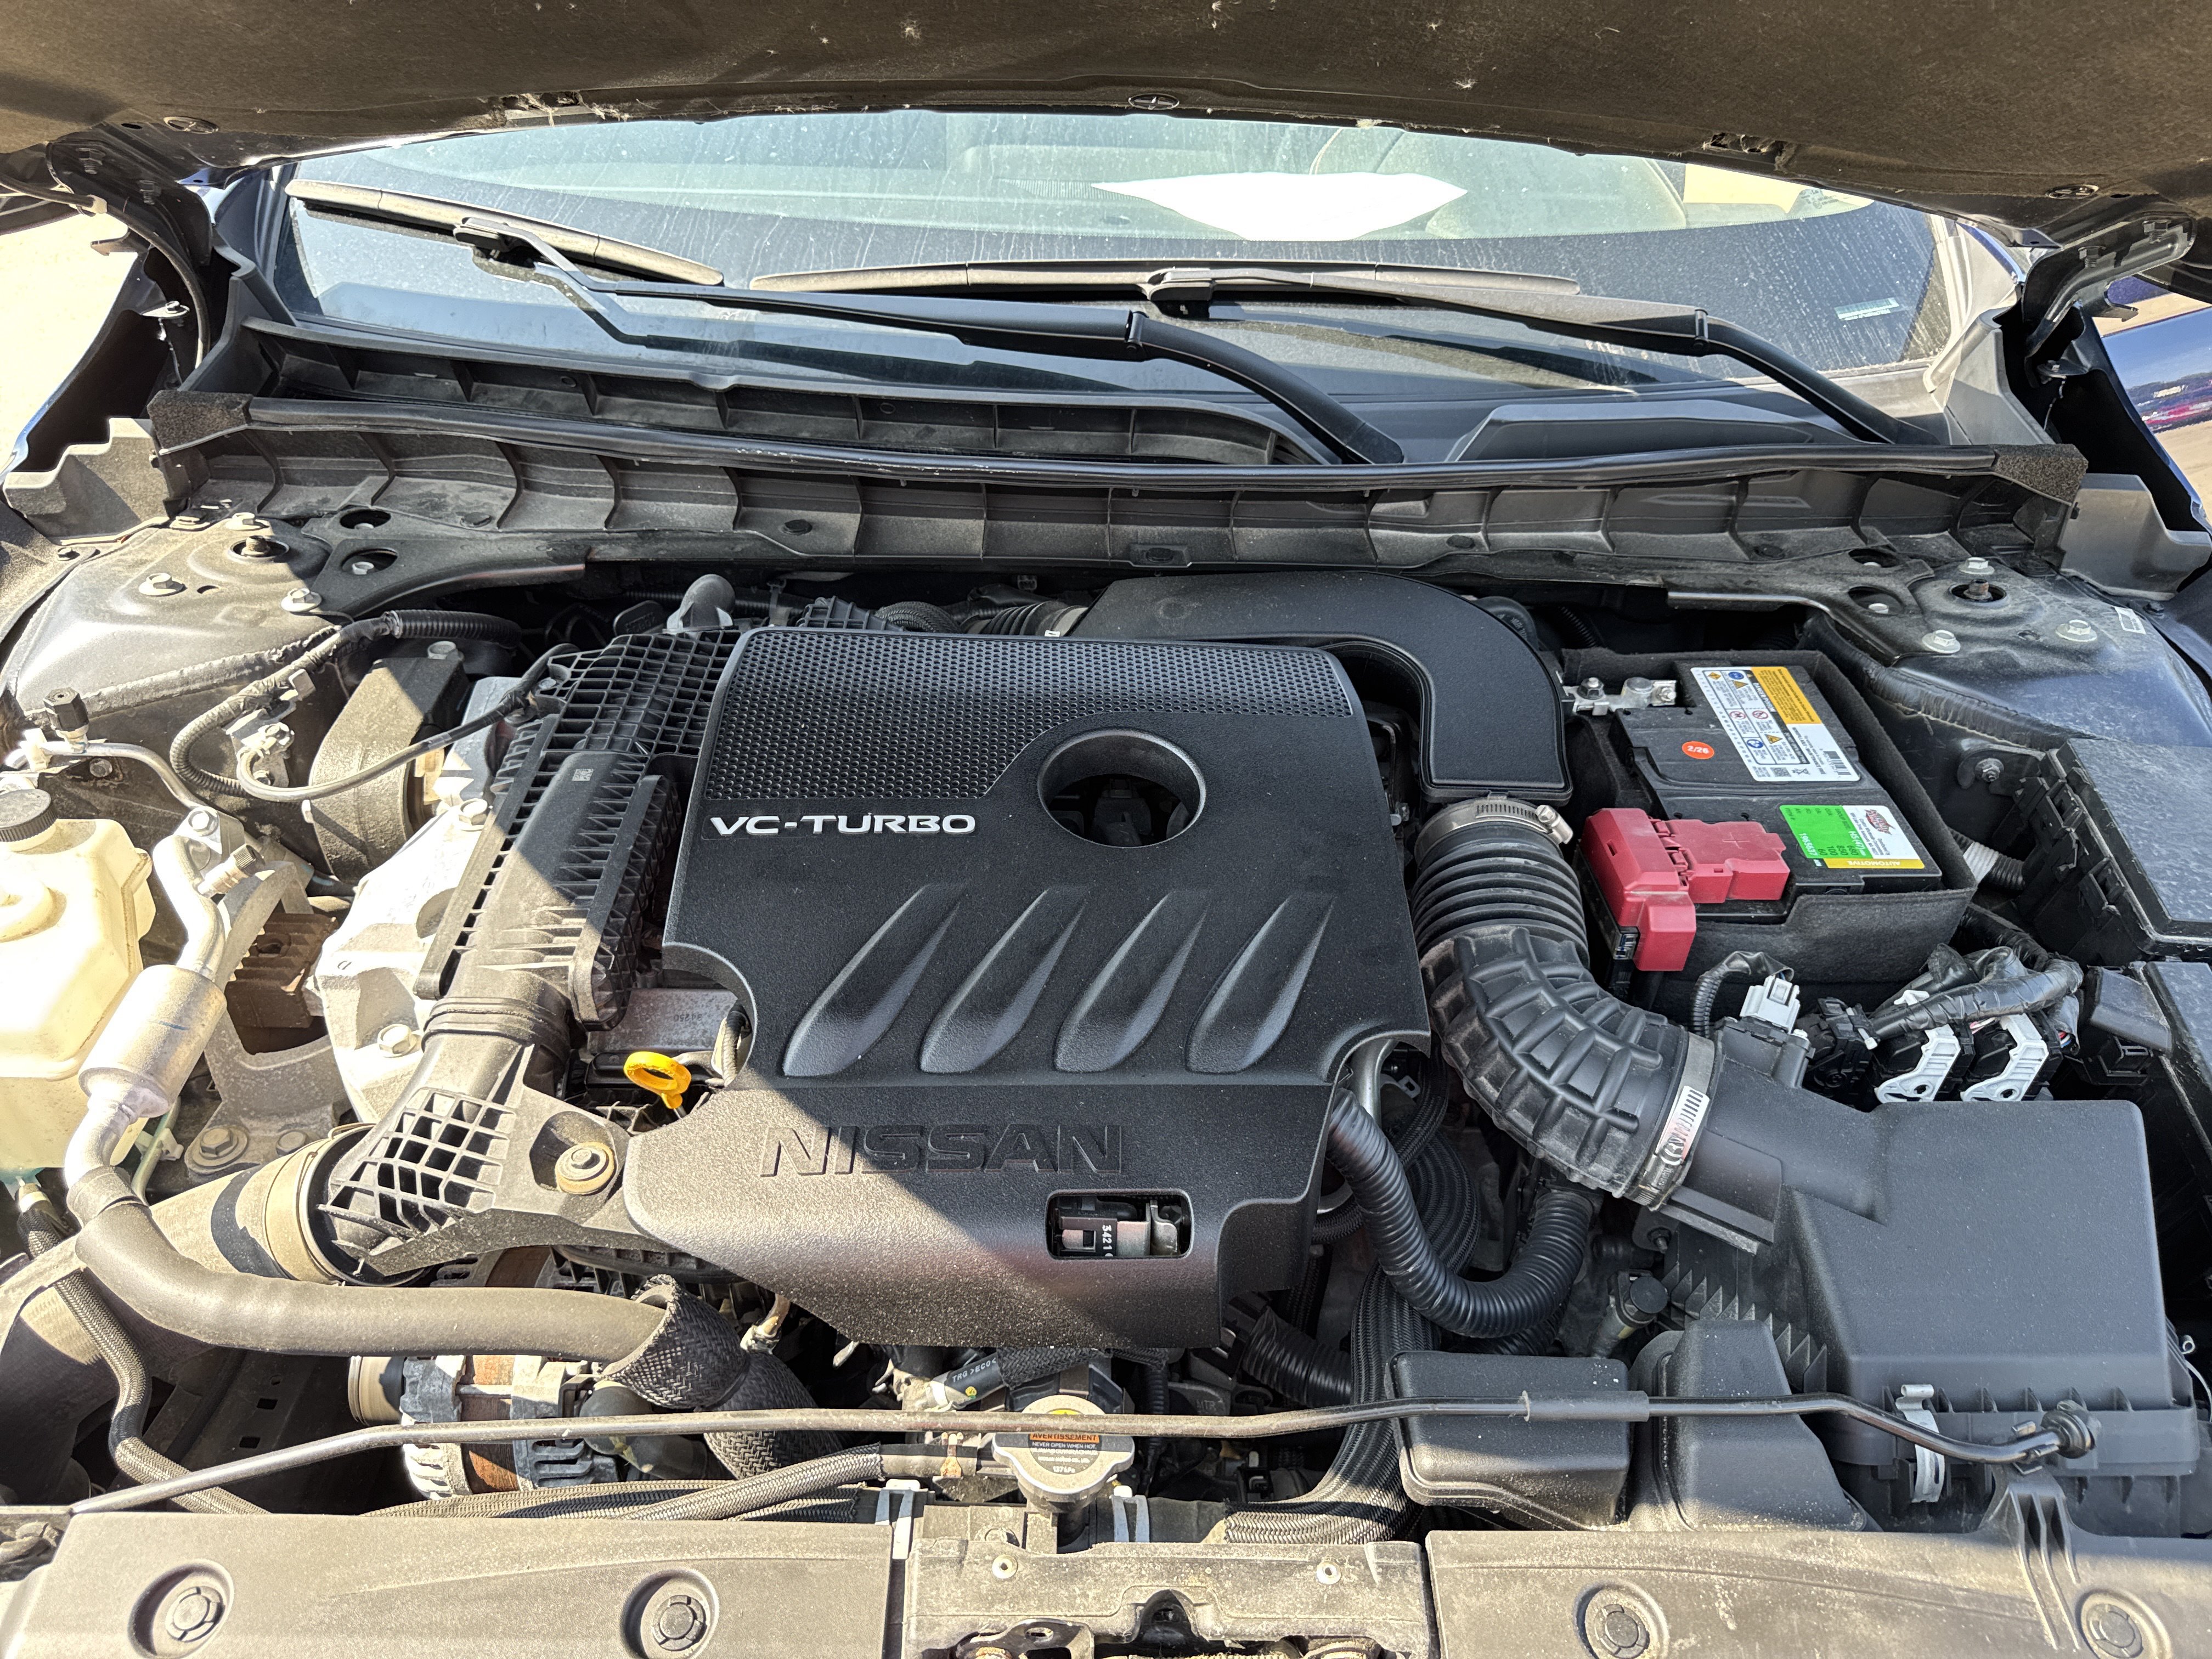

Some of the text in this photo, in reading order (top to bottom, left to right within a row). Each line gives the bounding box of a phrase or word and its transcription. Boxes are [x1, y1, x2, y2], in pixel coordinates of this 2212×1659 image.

[1688, 746, 1709, 754] 2/26
[710, 814, 975, 836] VC-TURBO
[760, 1124, 1122, 1177] NISSAN
[952, 1371, 968, 1383] TRG
[1032, 1432, 1097, 1441] AVERTISSEMENT
